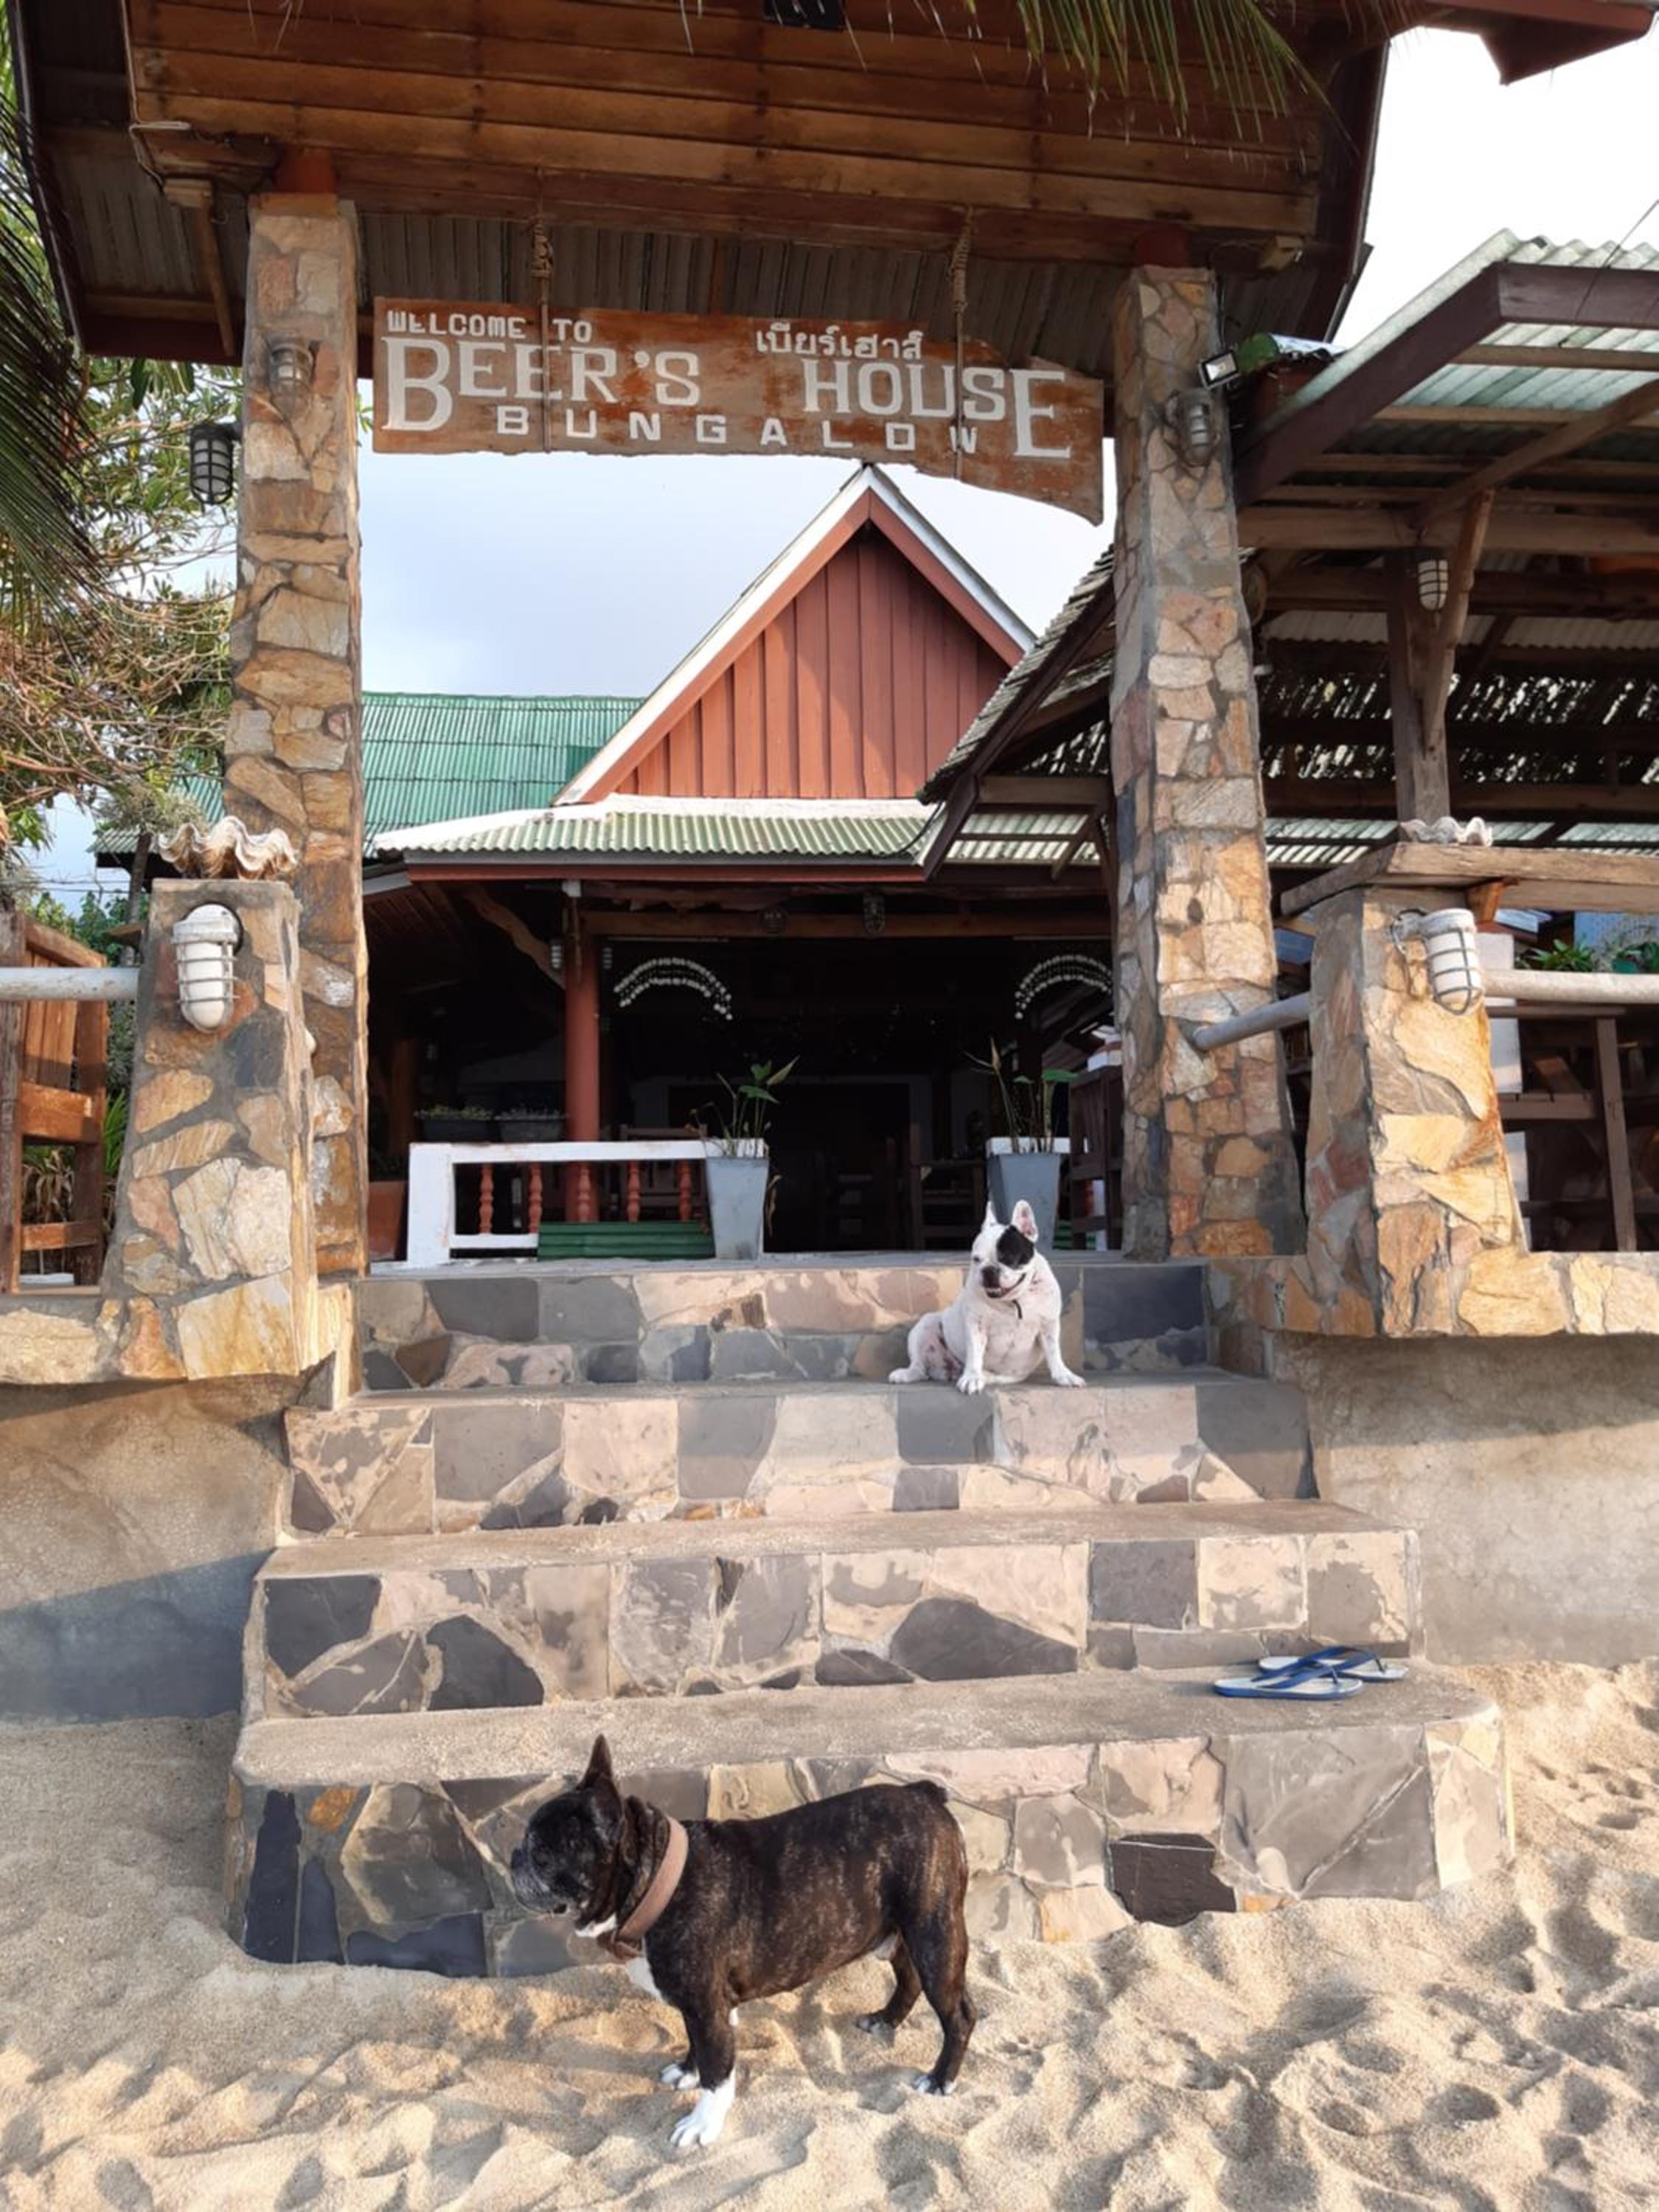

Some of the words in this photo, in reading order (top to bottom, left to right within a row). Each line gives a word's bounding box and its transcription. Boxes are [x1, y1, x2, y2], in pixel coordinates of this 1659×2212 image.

[386, 309, 526, 340] WELCOME
[552, 317, 592, 342] TO
[756, 321, 924, 360] เบียร์เฮาส์
[380, 335, 700, 432] BEER'S
[801, 358, 1072, 459] HOUSE
[495, 405, 978, 454] BUNGALOW
